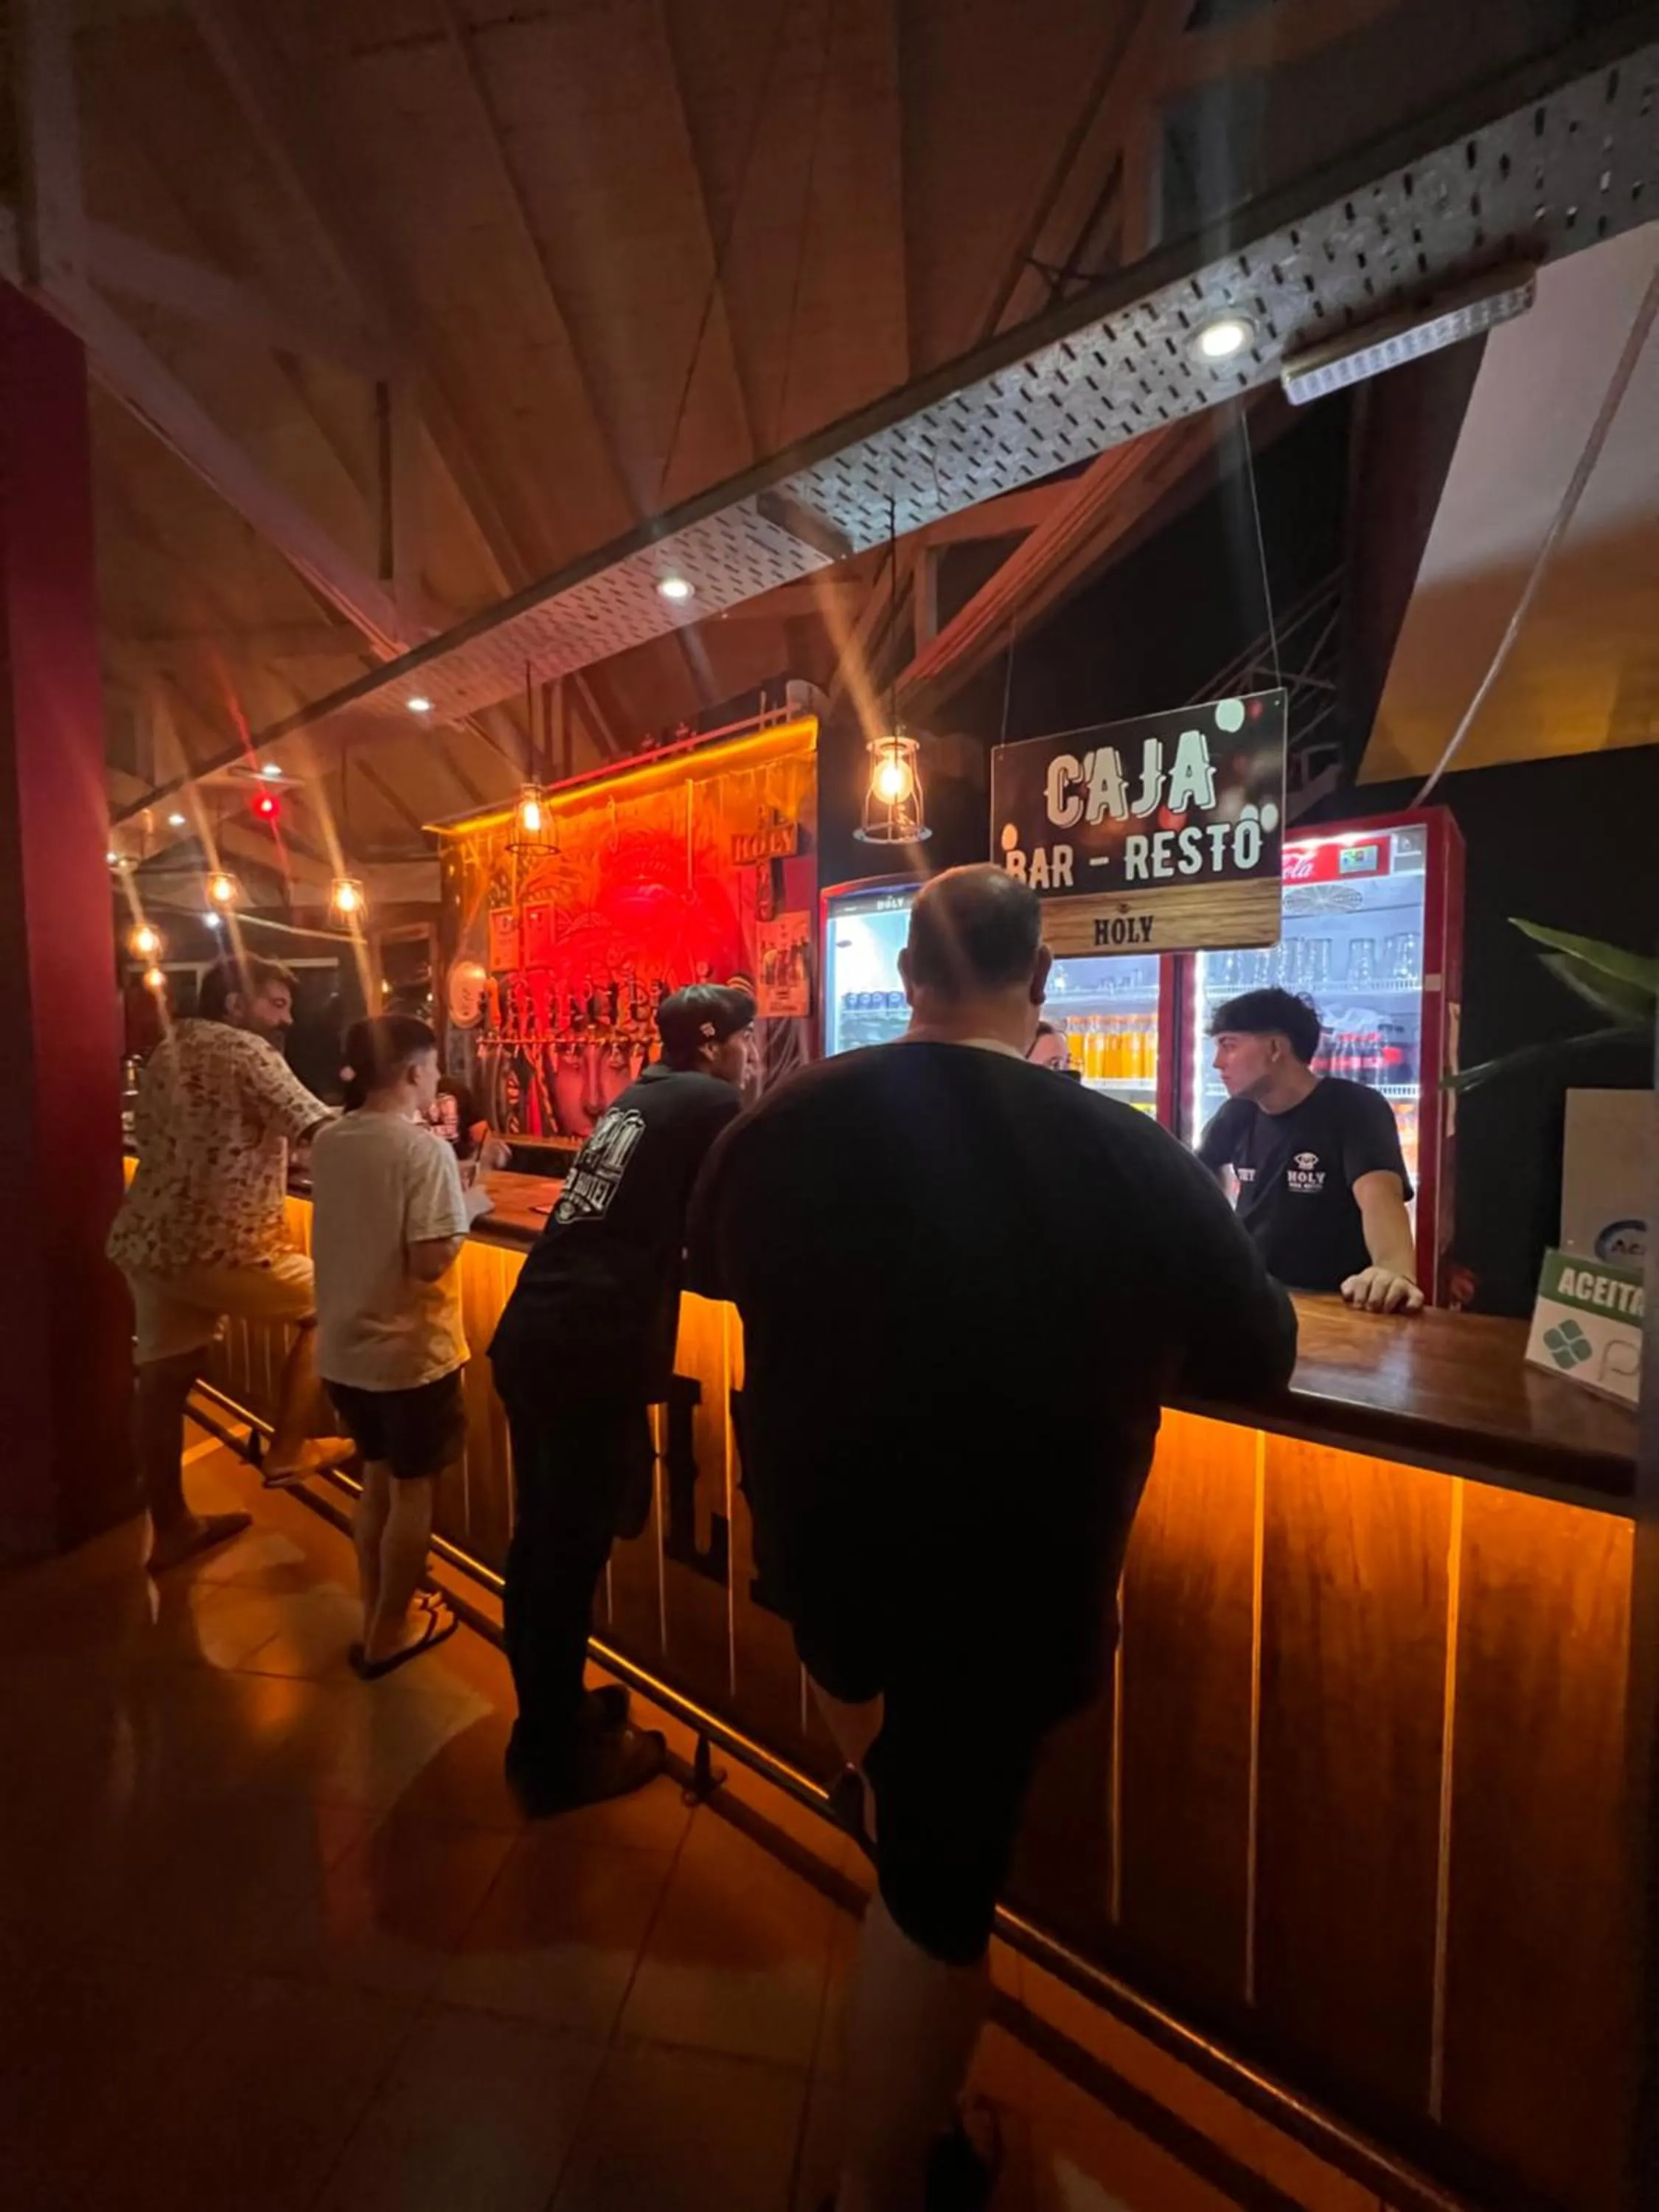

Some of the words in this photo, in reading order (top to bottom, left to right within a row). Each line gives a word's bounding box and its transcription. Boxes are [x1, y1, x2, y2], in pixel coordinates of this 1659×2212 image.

[1043, 729, 1217, 829] CAJA
[1005, 844, 1074, 889] BAR
[1093, 914, 1154, 947] HOLY
[1287, 1169, 1326, 1183] HOLY
